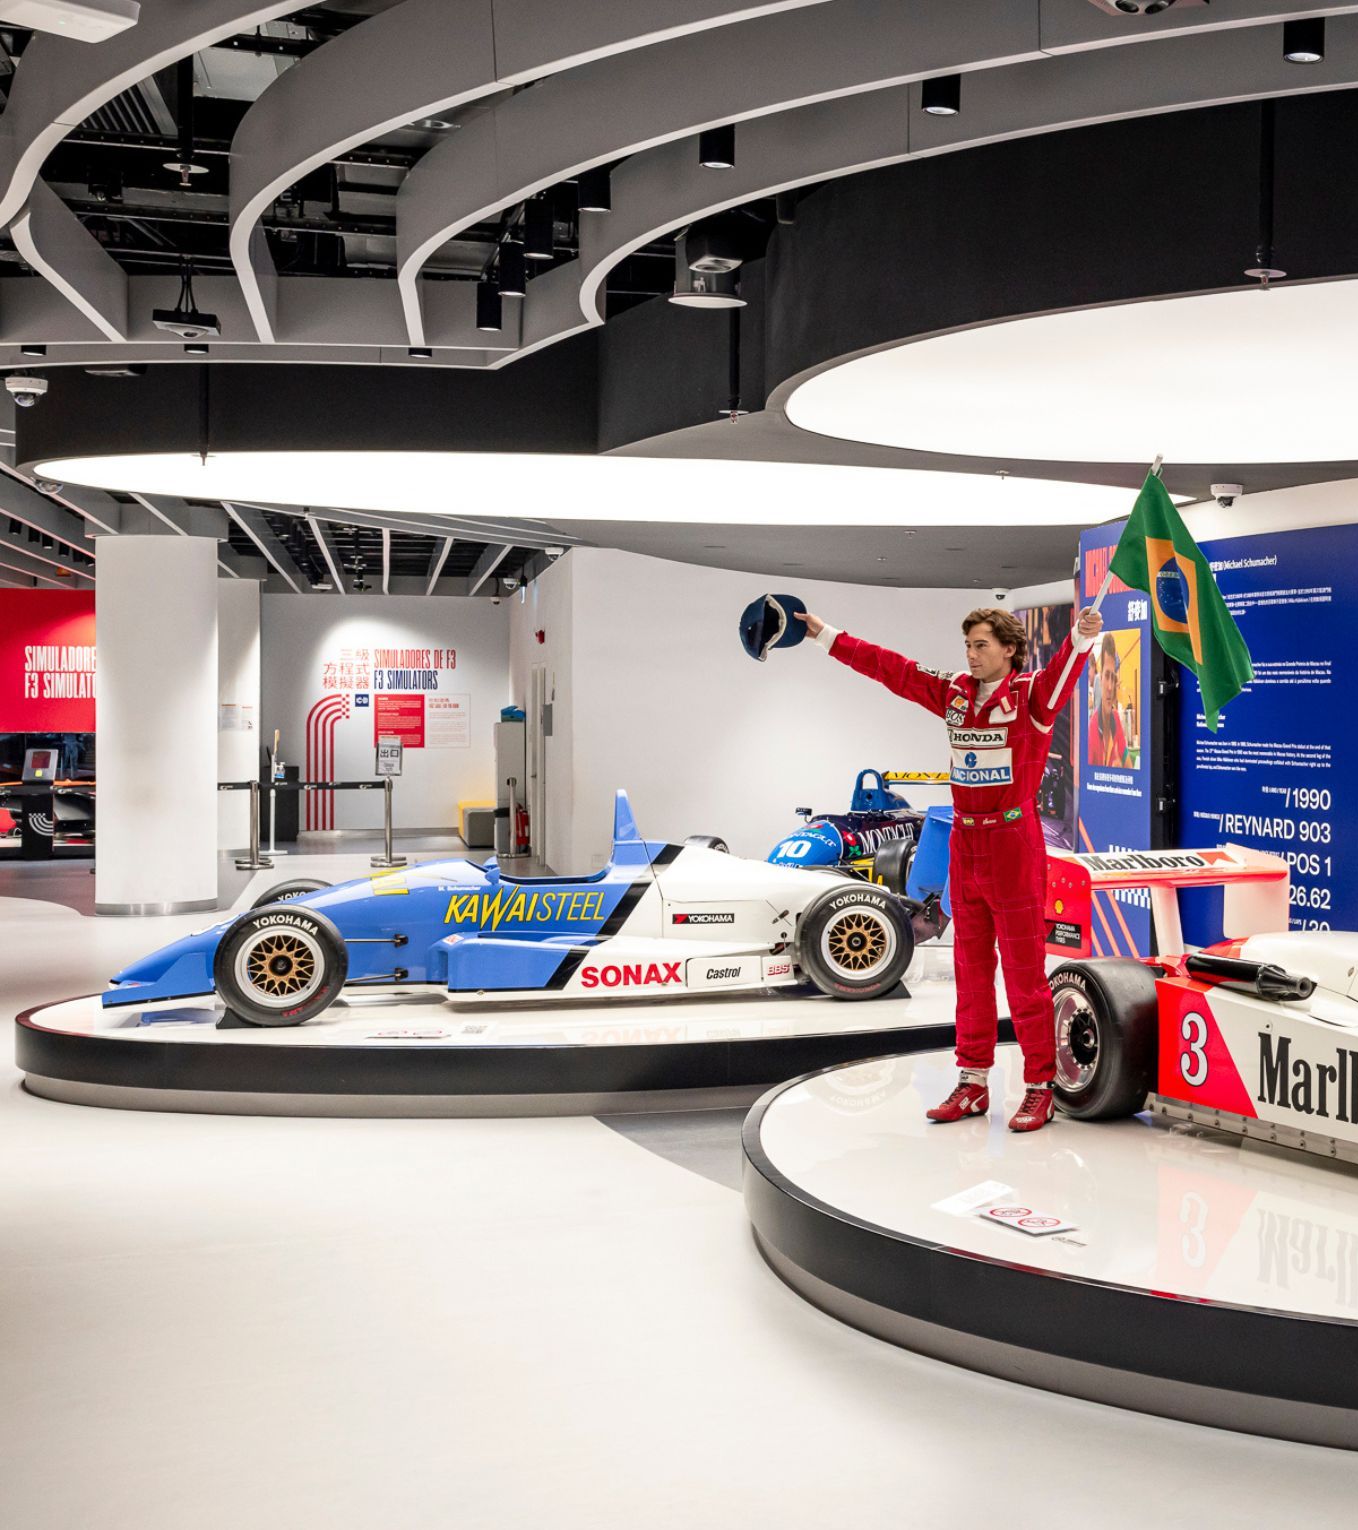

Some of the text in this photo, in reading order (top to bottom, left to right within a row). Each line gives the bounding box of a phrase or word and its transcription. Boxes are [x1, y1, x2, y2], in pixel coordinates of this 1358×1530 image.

[324, 662, 369, 675] 方程式
[374, 649, 456, 670] SIMULADORES DE F3
[24, 673, 39, 699] F3
[374, 670, 438, 690] F3 SIMULATORS
[954, 732, 1004, 742] HONDA
[380, 749, 399, 758] 出口
[1300, 821, 1331, 843] 903
[778, 840, 812, 858] 10
[1079, 853, 1206, 872] Marlboro
[1325, 856, 1331, 876] 1
[278, 891, 306, 902] YOKO
[830, 893, 886, 910] YOKOHAMA
[253, 915, 319, 936] YOKOHAMA
[688, 914, 733, 923] YOKOHAMA
[581, 962, 682, 988] SONAX
[706, 966, 741, 980] Castrol
[768, 964, 790, 975] BBS
[1050, 972, 1086, 991] OKOHAMA
[1180, 1011, 1208, 1086] 3
